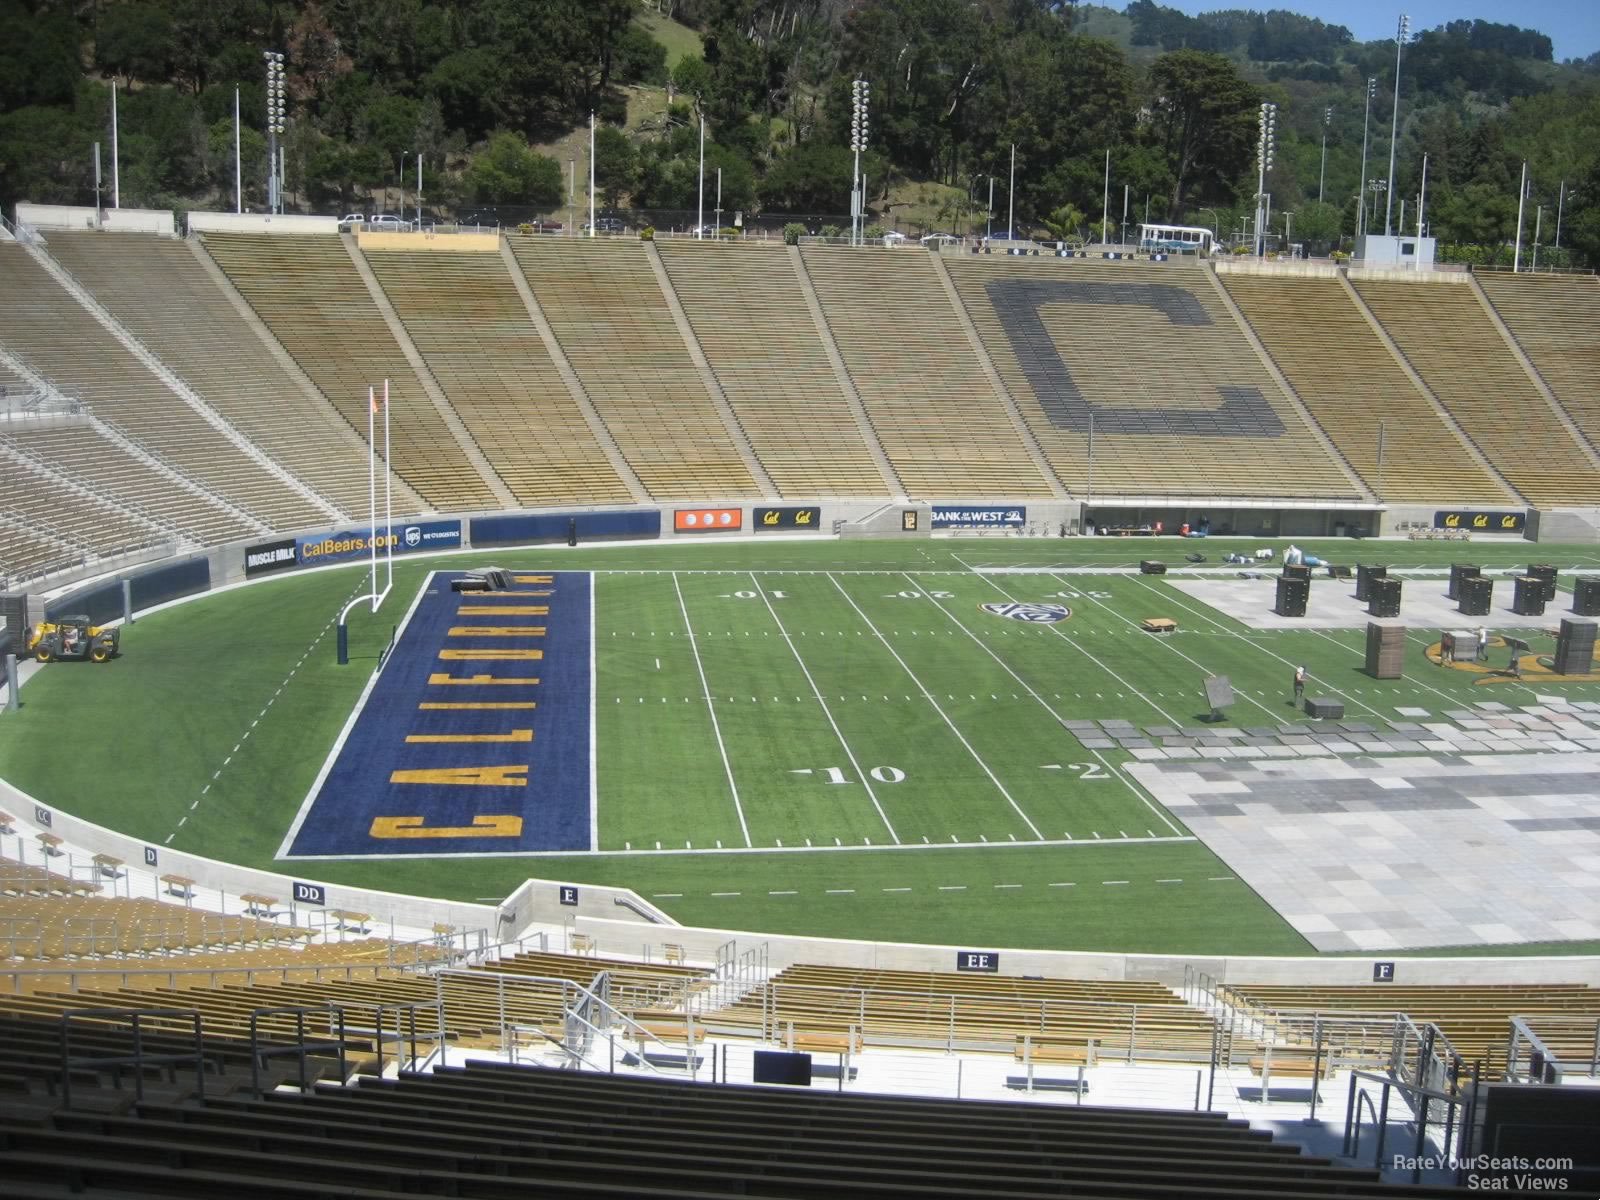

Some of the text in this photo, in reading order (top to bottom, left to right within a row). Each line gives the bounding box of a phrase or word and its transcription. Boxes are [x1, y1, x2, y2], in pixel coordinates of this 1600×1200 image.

[984, 278, 1287, 437] C
[763, 511, 779, 524] Cal
[795, 510, 812, 524] Cal
[931, 512, 961, 521] BANK
[971, 512, 1005, 521] WEST
[1446, 514, 1460, 527] Cal
[1473, 514, 1488, 527] Cal
[1502, 515, 1516, 528] Cal
[303, 533, 398, 557] CalBears.com
[248, 547, 296, 567] MUSCLE MILK
[38, 809, 49, 822] CC
[147, 850, 155, 861] D
[299, 885, 319, 900] DD
[565, 889, 574, 902] E
[967, 954, 989, 968] EE
[1379, 965, 1390, 978] F
